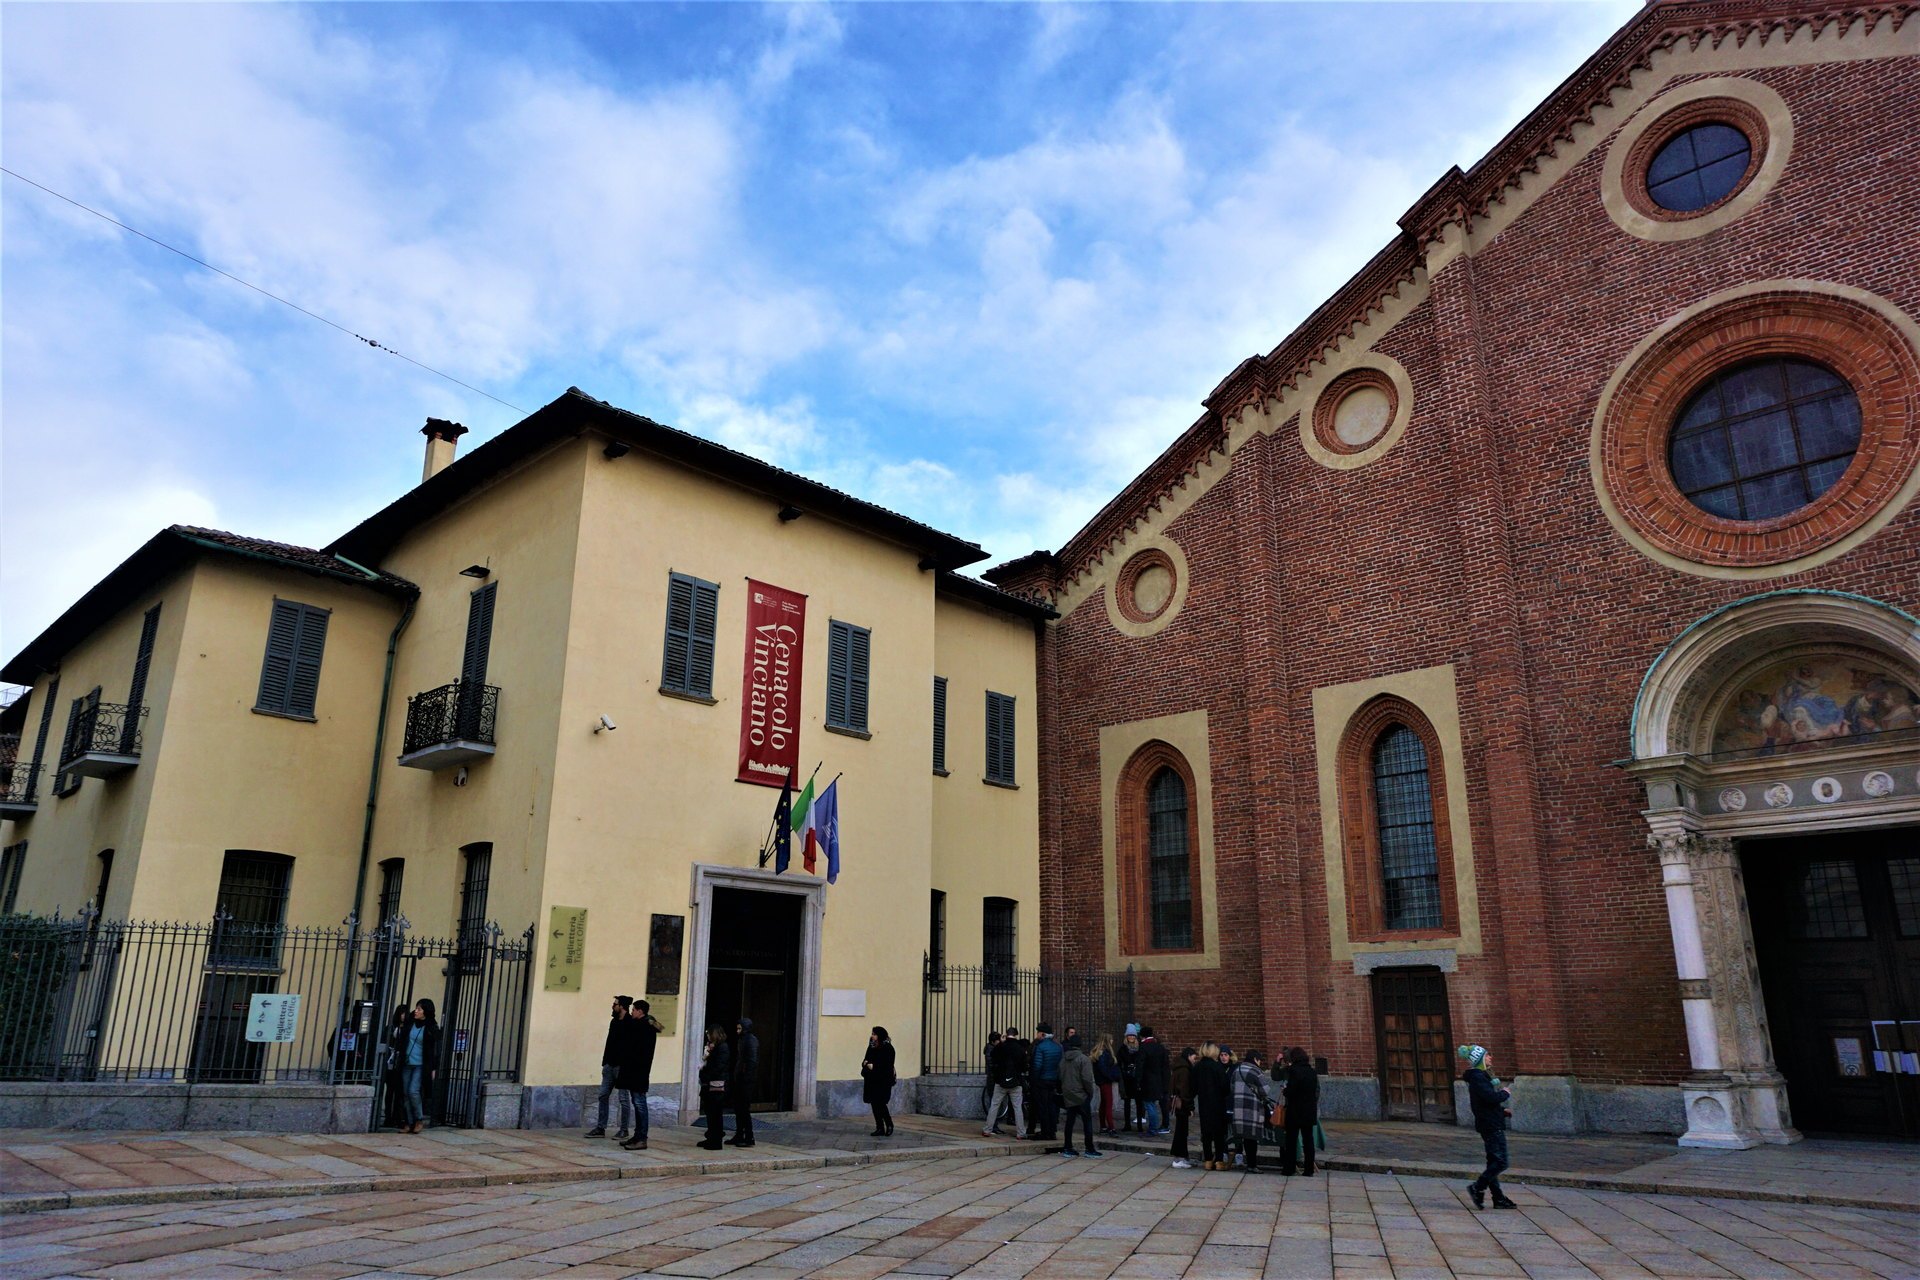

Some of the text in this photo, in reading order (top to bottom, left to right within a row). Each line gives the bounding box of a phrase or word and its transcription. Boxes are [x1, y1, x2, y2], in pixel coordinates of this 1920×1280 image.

[750, 623, 777, 746] Vinciano
[771, 624, 798, 750] Cenacolo
[566, 916, 577, 964] Biglietteria
[574, 911, 586, 964] Ticket Office
[276, 1000, 288, 1041] Biglietteria
[284, 1019, 294, 1040] Ticket
